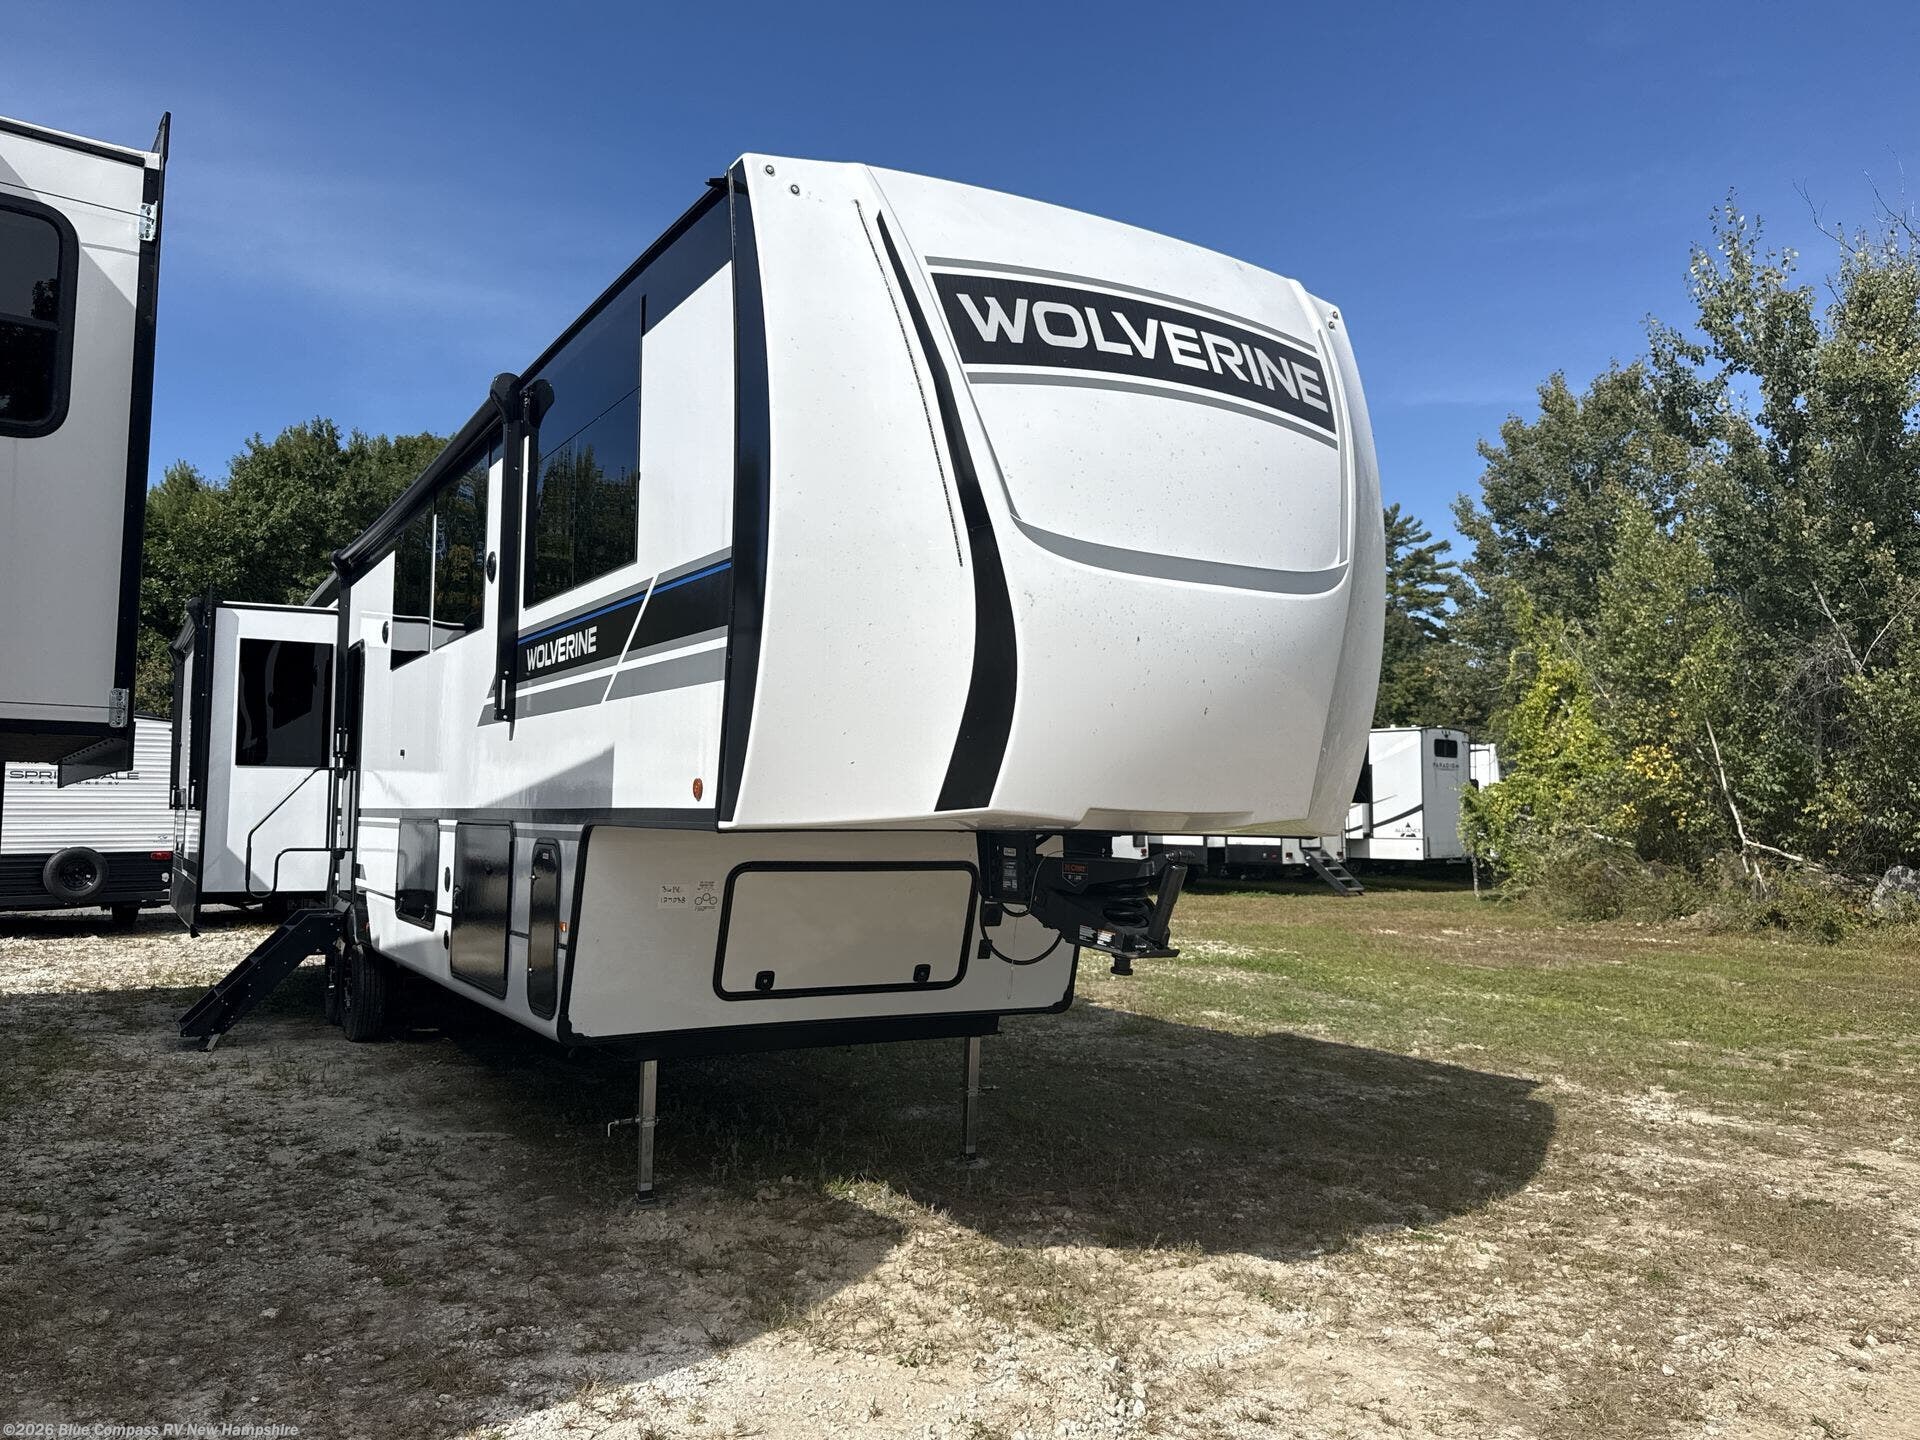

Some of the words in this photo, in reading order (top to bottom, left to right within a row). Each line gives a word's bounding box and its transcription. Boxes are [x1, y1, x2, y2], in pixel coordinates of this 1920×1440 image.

[956, 293, 1329, 413] WOLVERINE
[526, 626, 598, 671] WOLVERINE
[9, 770, 140, 780] SPRIALE
